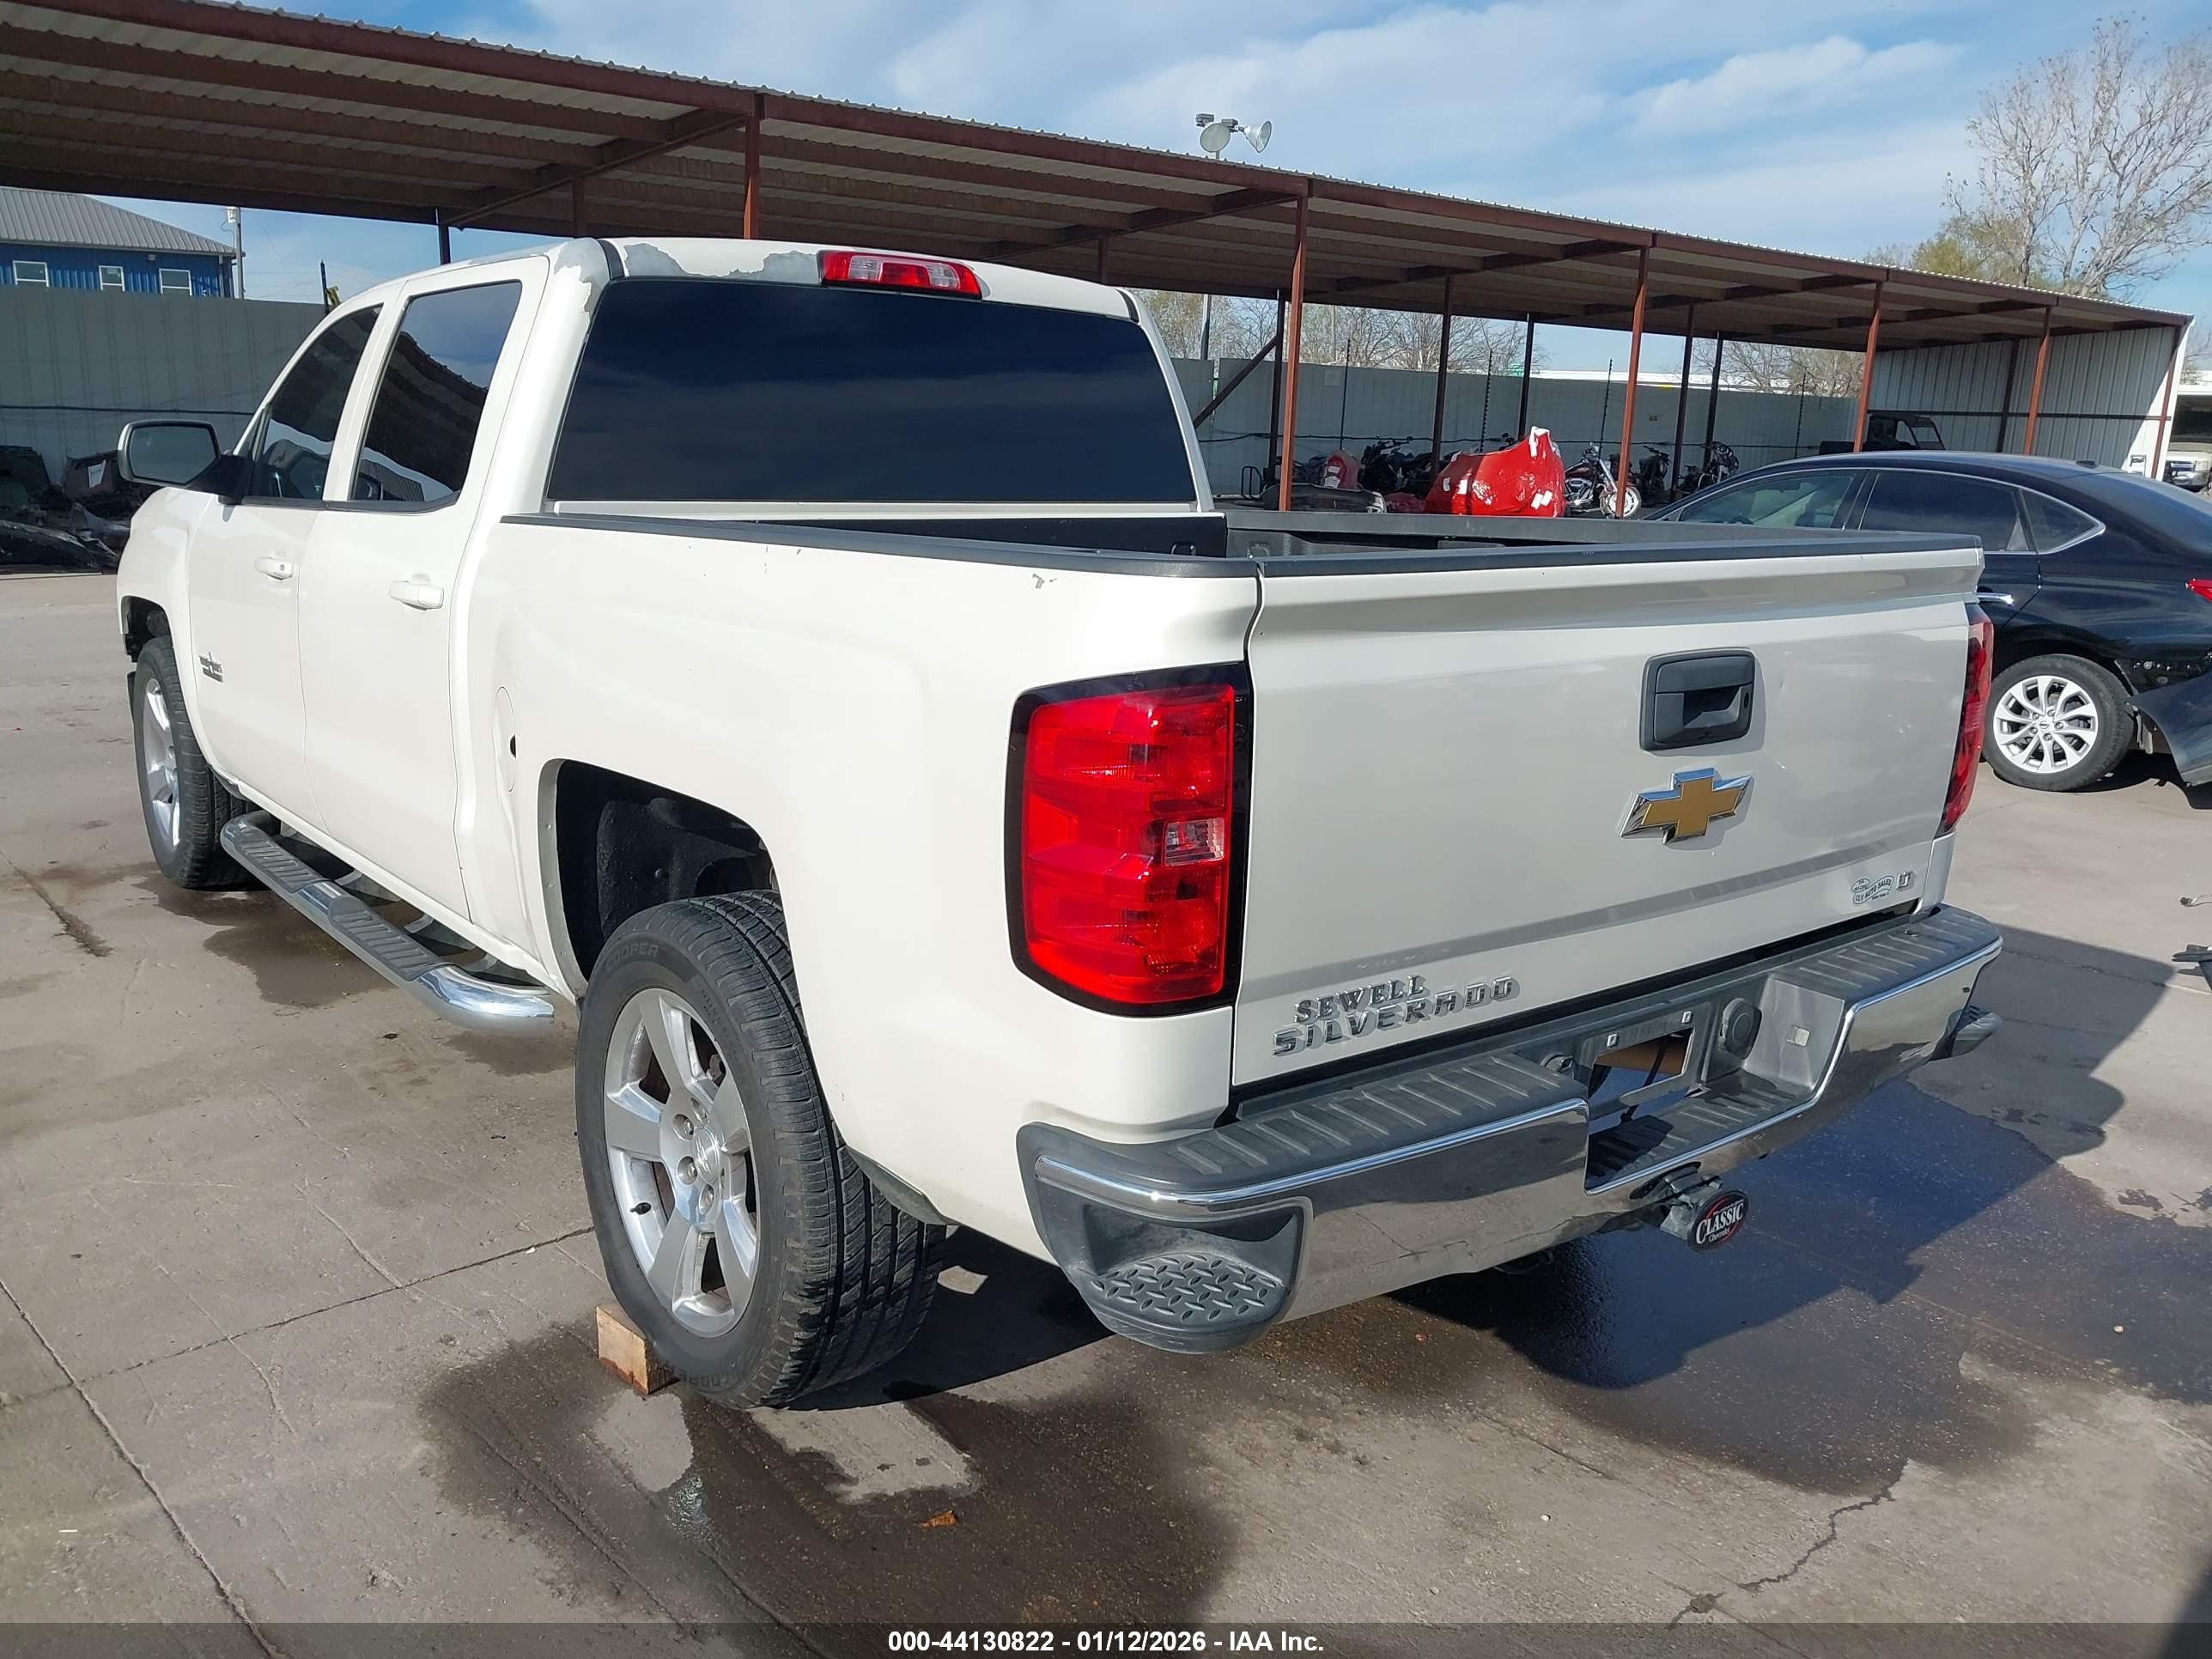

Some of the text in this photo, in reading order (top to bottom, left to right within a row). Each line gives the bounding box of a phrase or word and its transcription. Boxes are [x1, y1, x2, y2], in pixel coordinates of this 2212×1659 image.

[1272, 975, 1514, 1057] SILVERADO
[1293, 975, 1426, 1024] SEWELL
[1696, 1203, 1744, 1244] CLASSIC
